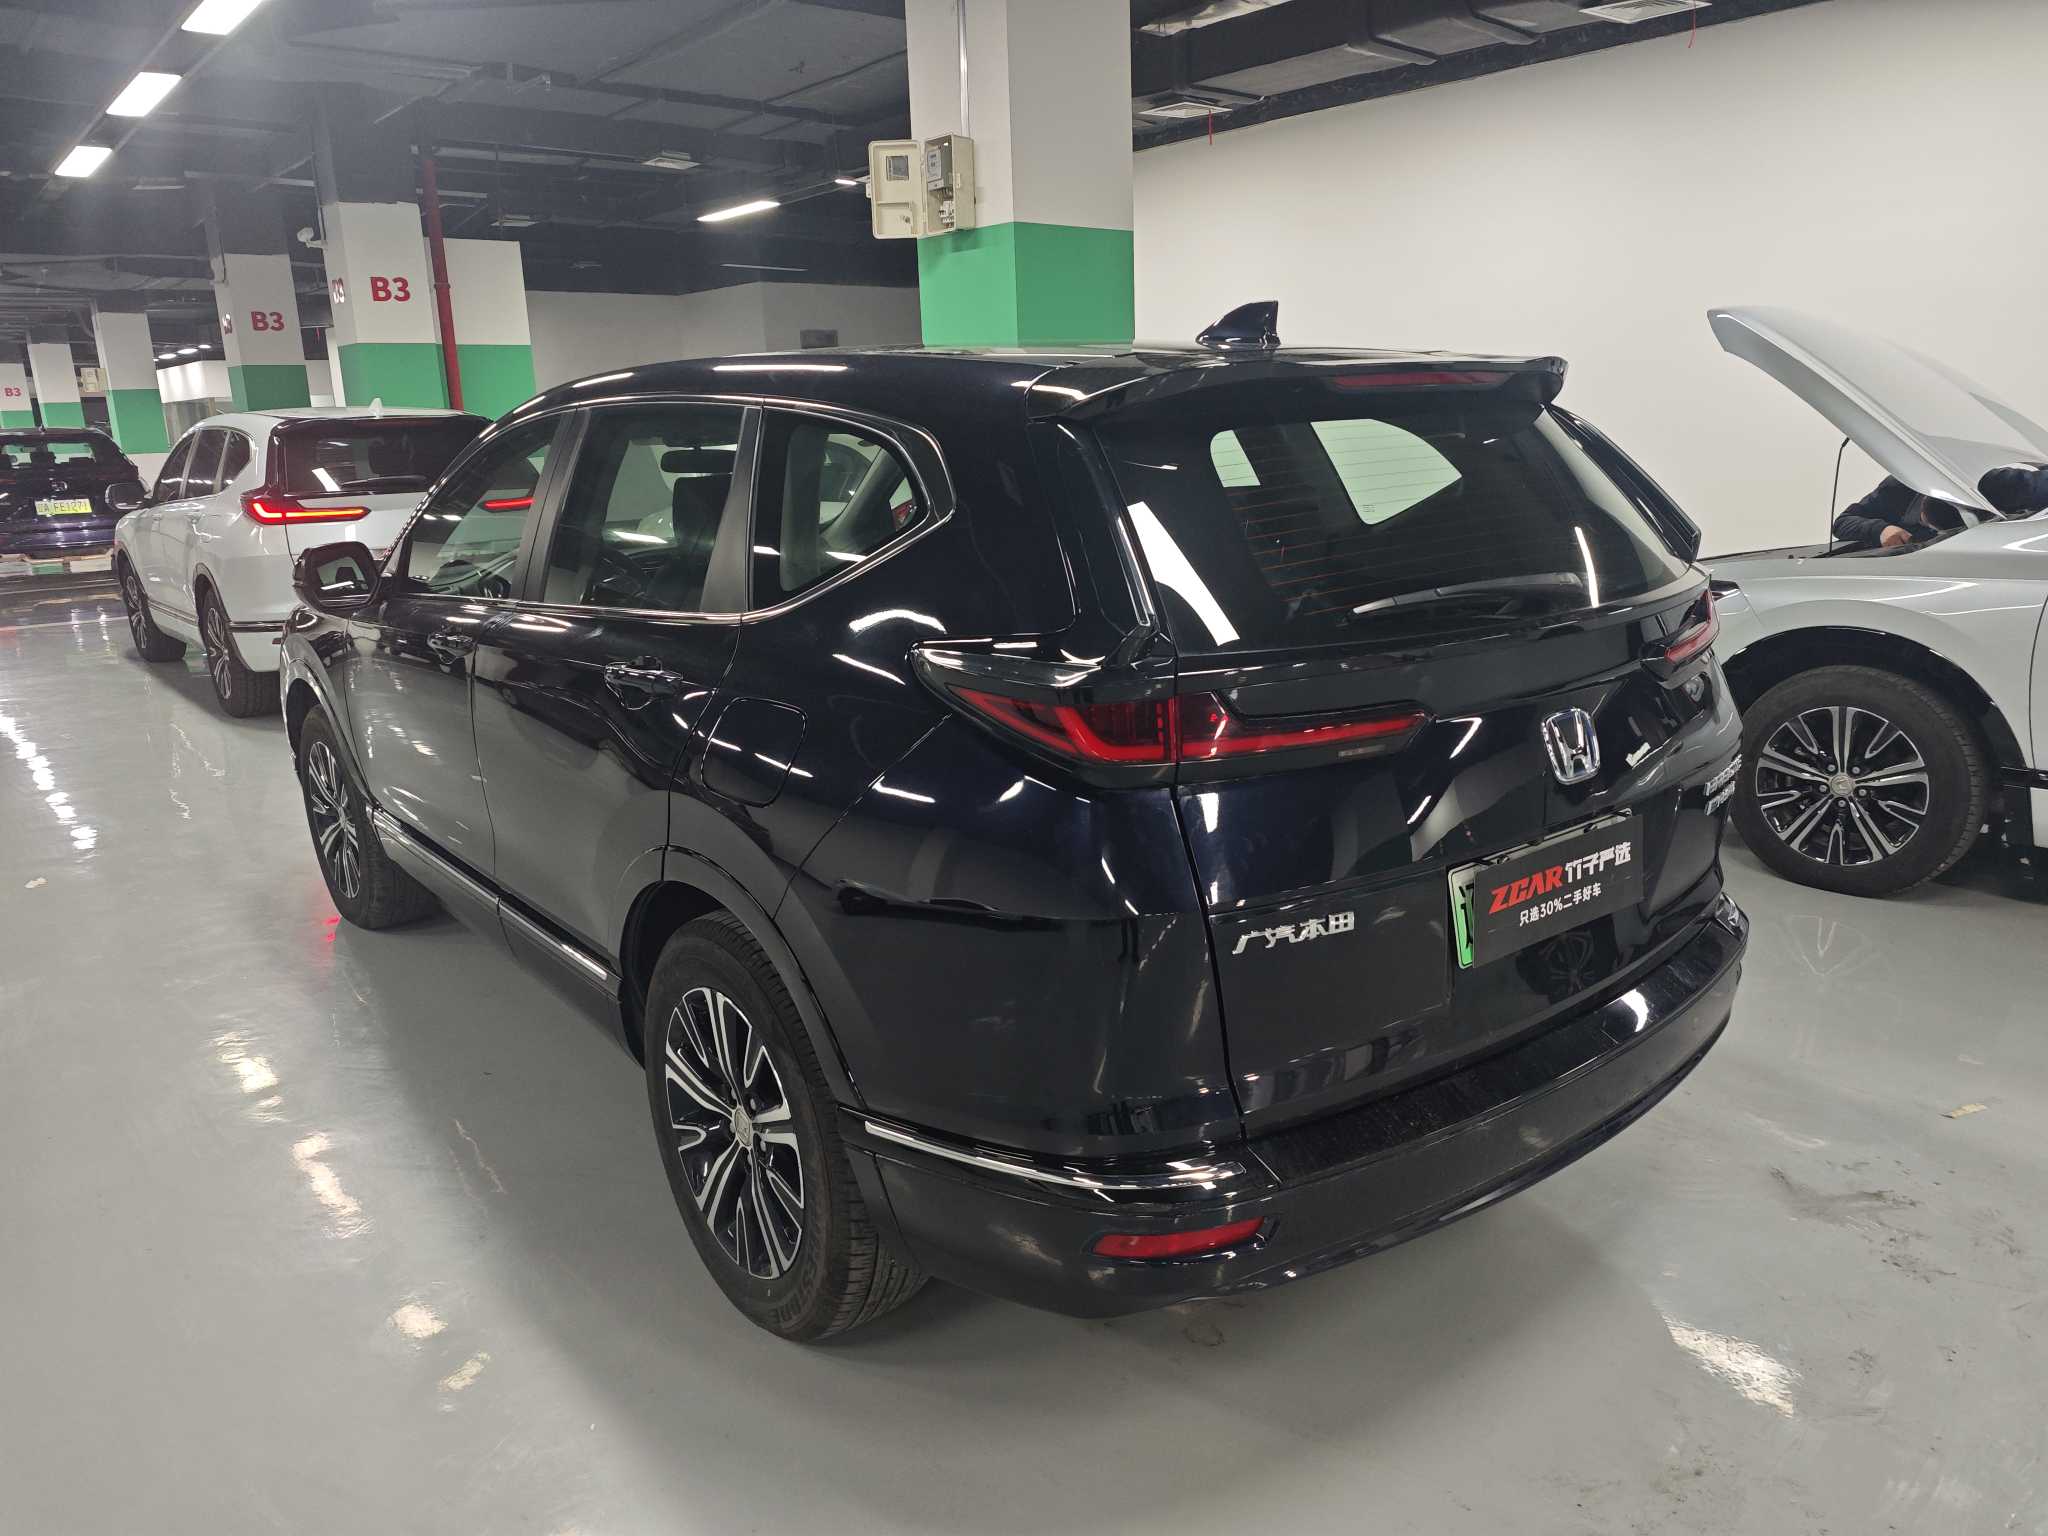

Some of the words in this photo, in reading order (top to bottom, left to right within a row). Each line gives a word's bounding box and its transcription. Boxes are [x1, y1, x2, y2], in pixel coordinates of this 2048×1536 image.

[370, 277, 411, 302] B3
[251, 311, 285, 331] B3
[4, 387, 22, 397] B3
[1489, 865, 1563, 914] ZCAR
[1519, 882, 1602, 927] 只选30%二手好车
[1232, 911, 1355, 955] 广汽本田
